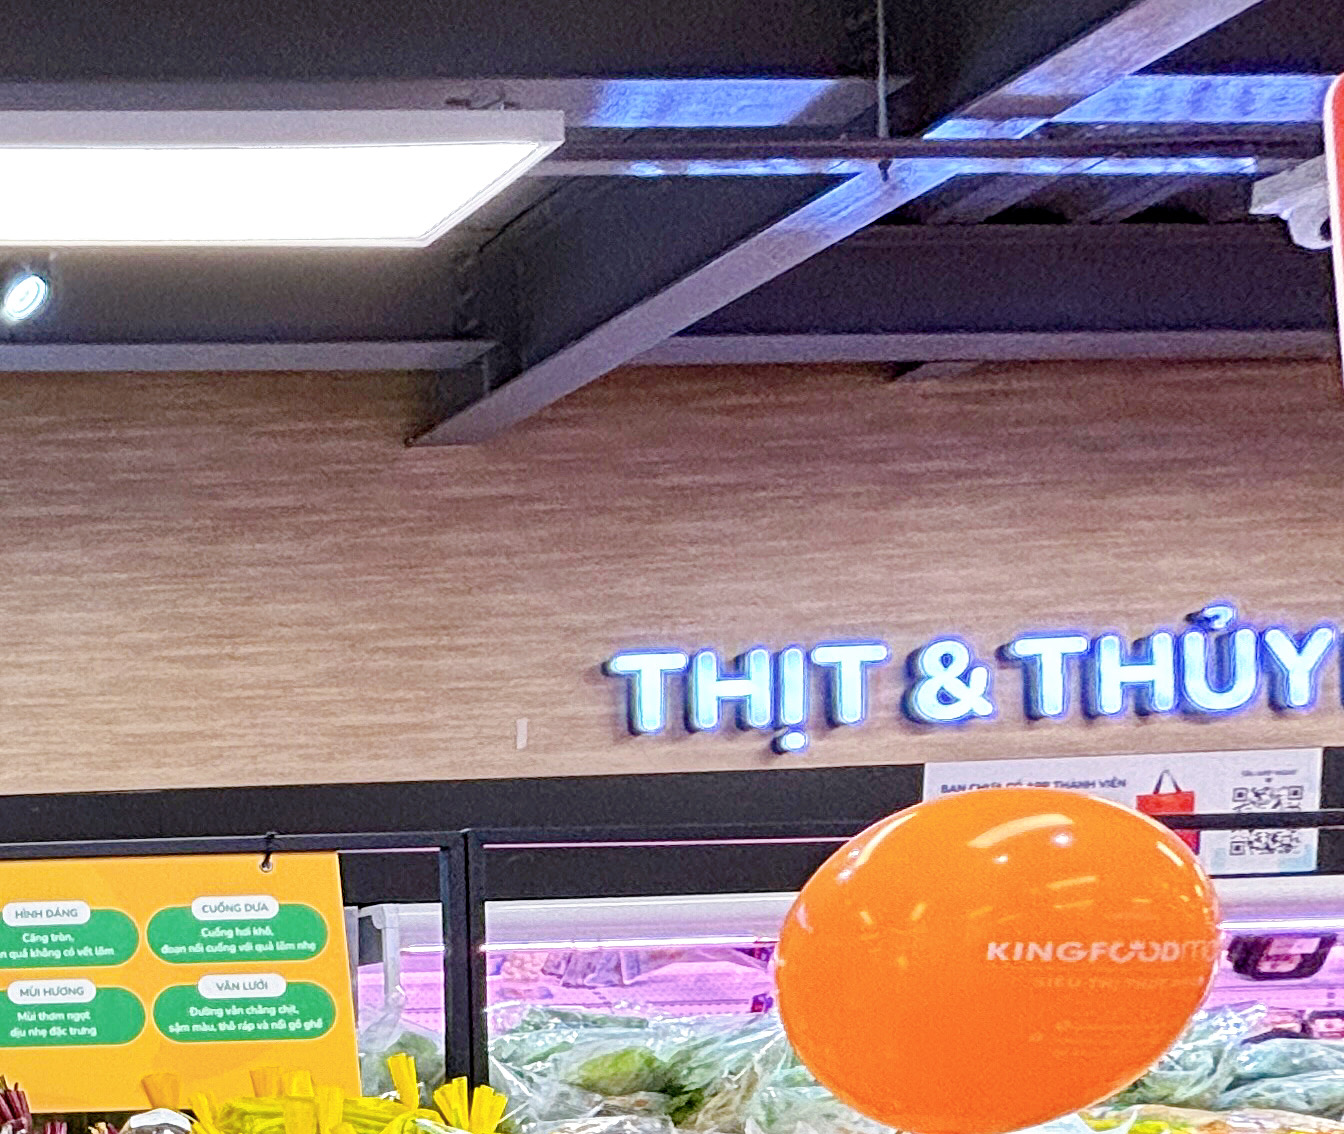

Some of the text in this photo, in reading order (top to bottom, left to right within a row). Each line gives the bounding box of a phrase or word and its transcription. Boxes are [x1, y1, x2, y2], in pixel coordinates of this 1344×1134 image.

[608, 602, 1338, 753] THỊT & THỦY
[46, 907, 78, 918] DÁNG
[19, 986, 85, 997] MÙI HƯƠNG
[17, 1011, 36, 1021] Mùi
